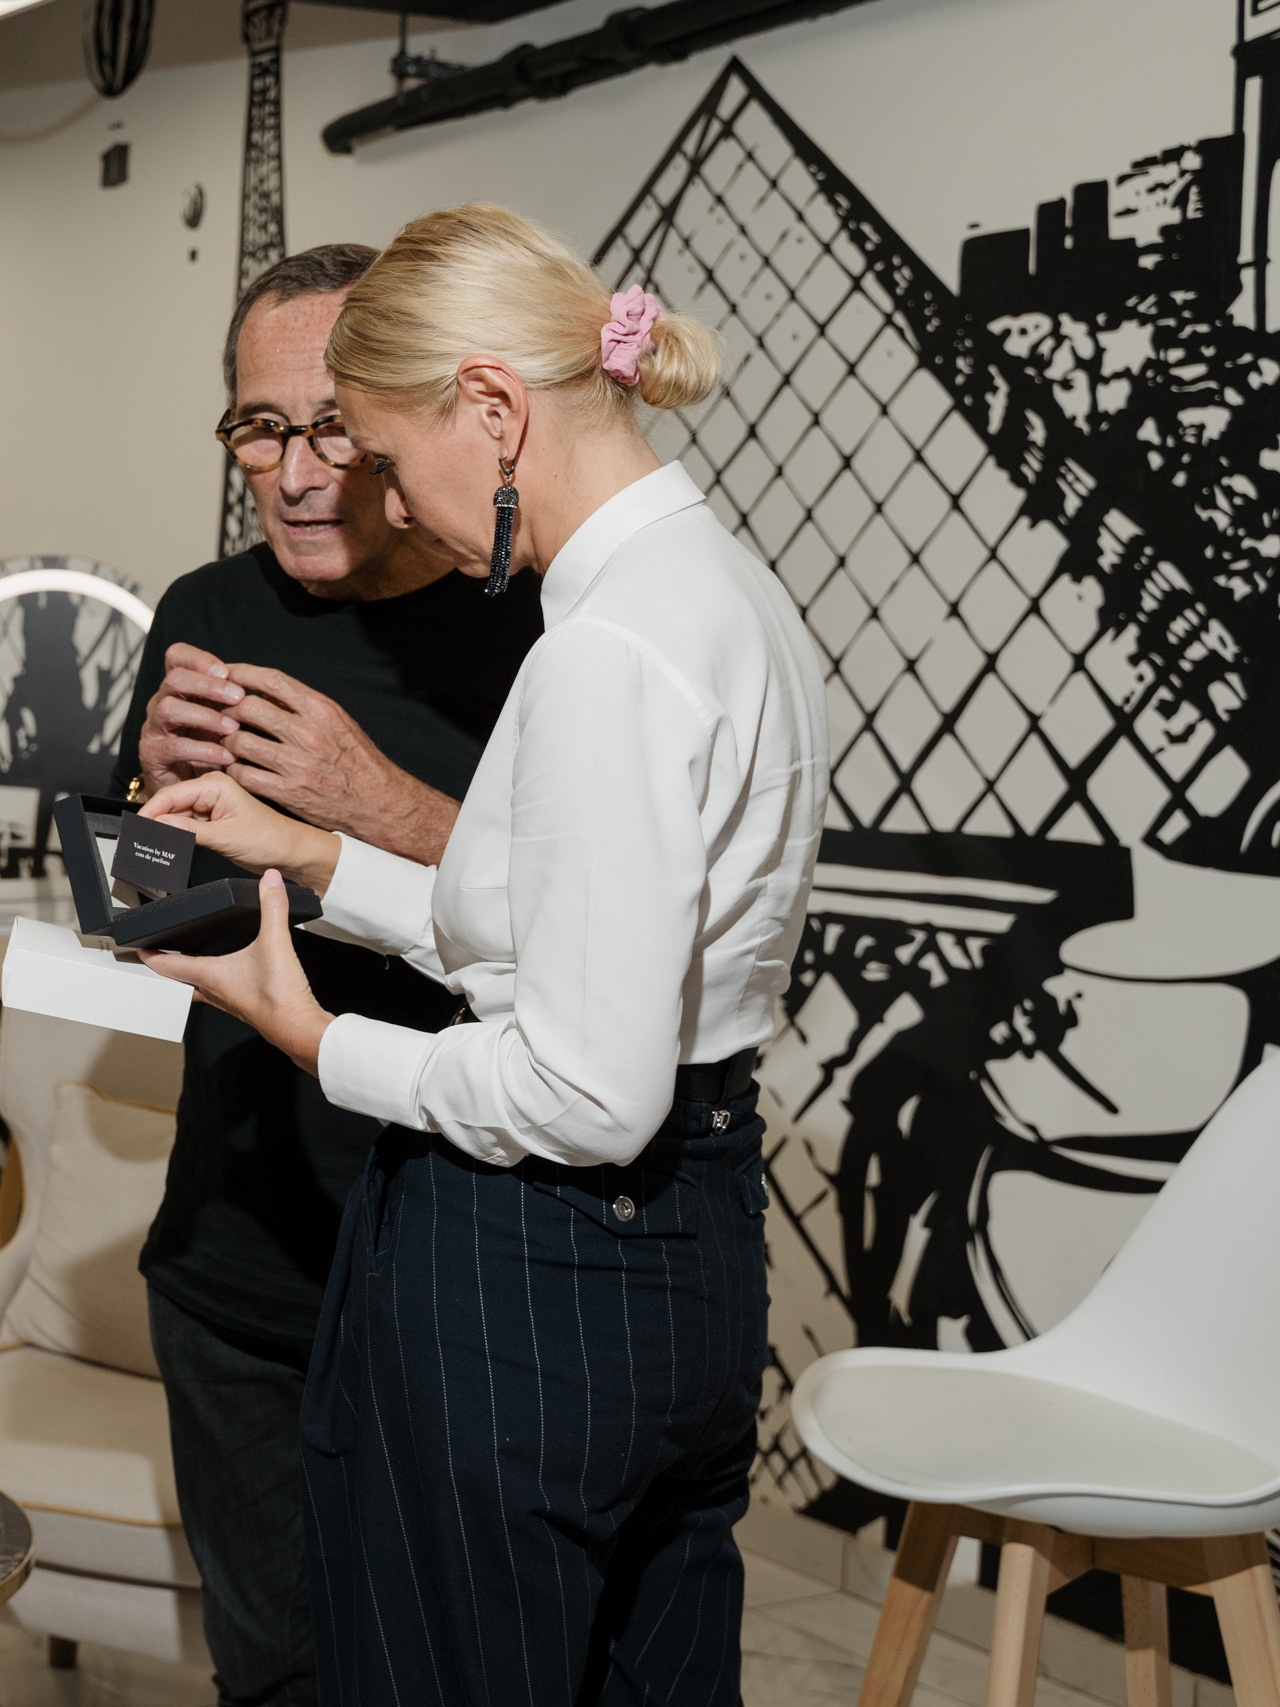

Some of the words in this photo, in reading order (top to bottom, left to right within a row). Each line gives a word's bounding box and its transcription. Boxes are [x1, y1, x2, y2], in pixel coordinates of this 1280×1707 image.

[134, 842, 154, 854] Vacation
[162, 851, 176, 860] MAF
[152, 856, 170, 866] parfum
